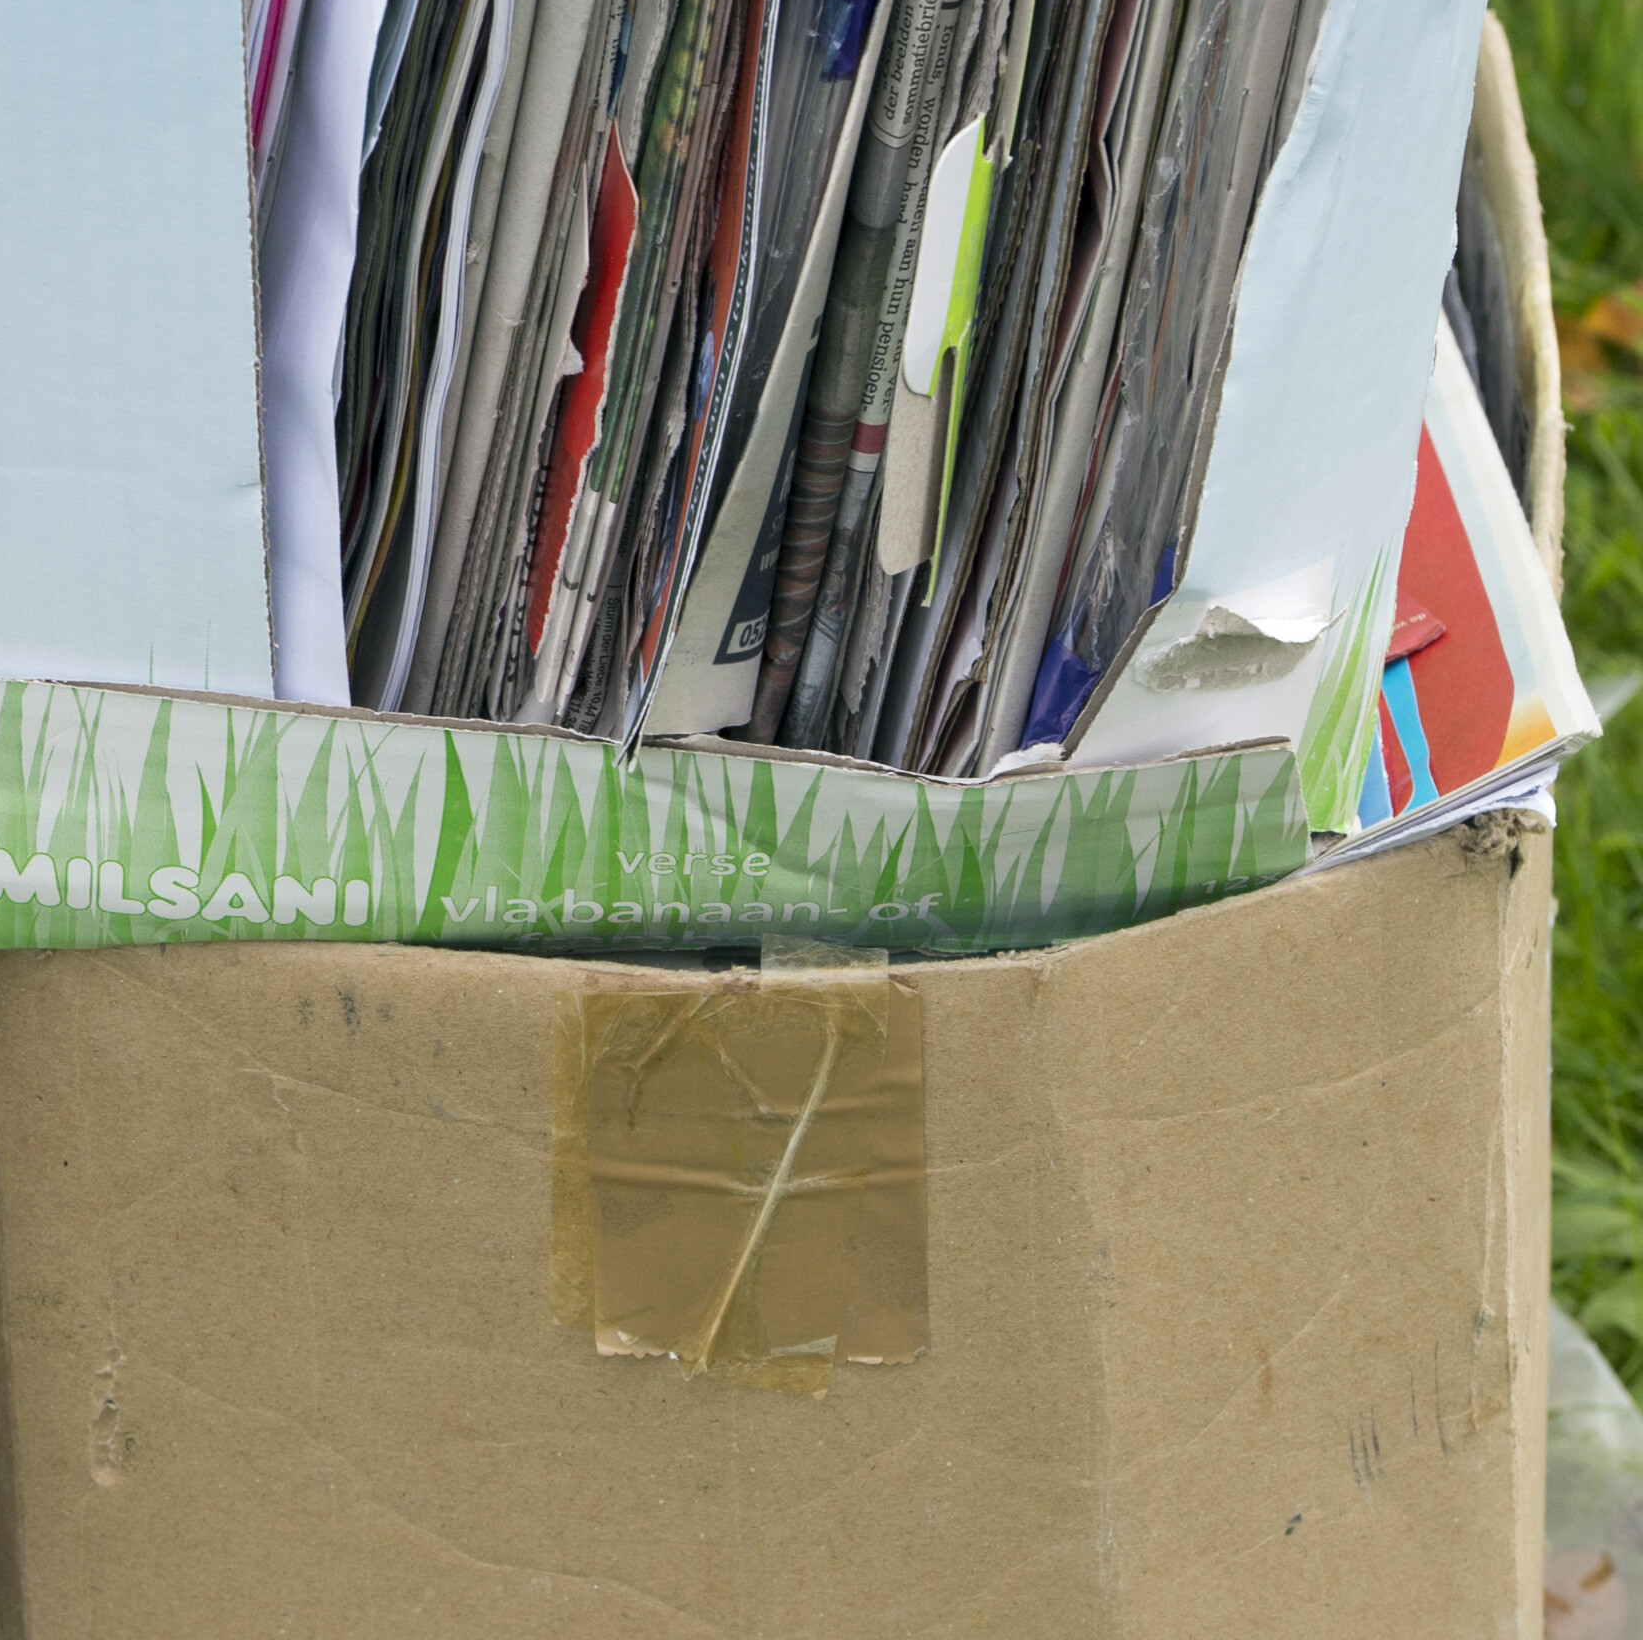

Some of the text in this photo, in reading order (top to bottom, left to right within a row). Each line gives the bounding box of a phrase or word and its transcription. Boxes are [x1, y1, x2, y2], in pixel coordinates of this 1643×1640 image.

[888, 3, 915, 83] beelden
[615, 846, 772, 880] verse
[439, 885, 948, 926] vla banaan- of
